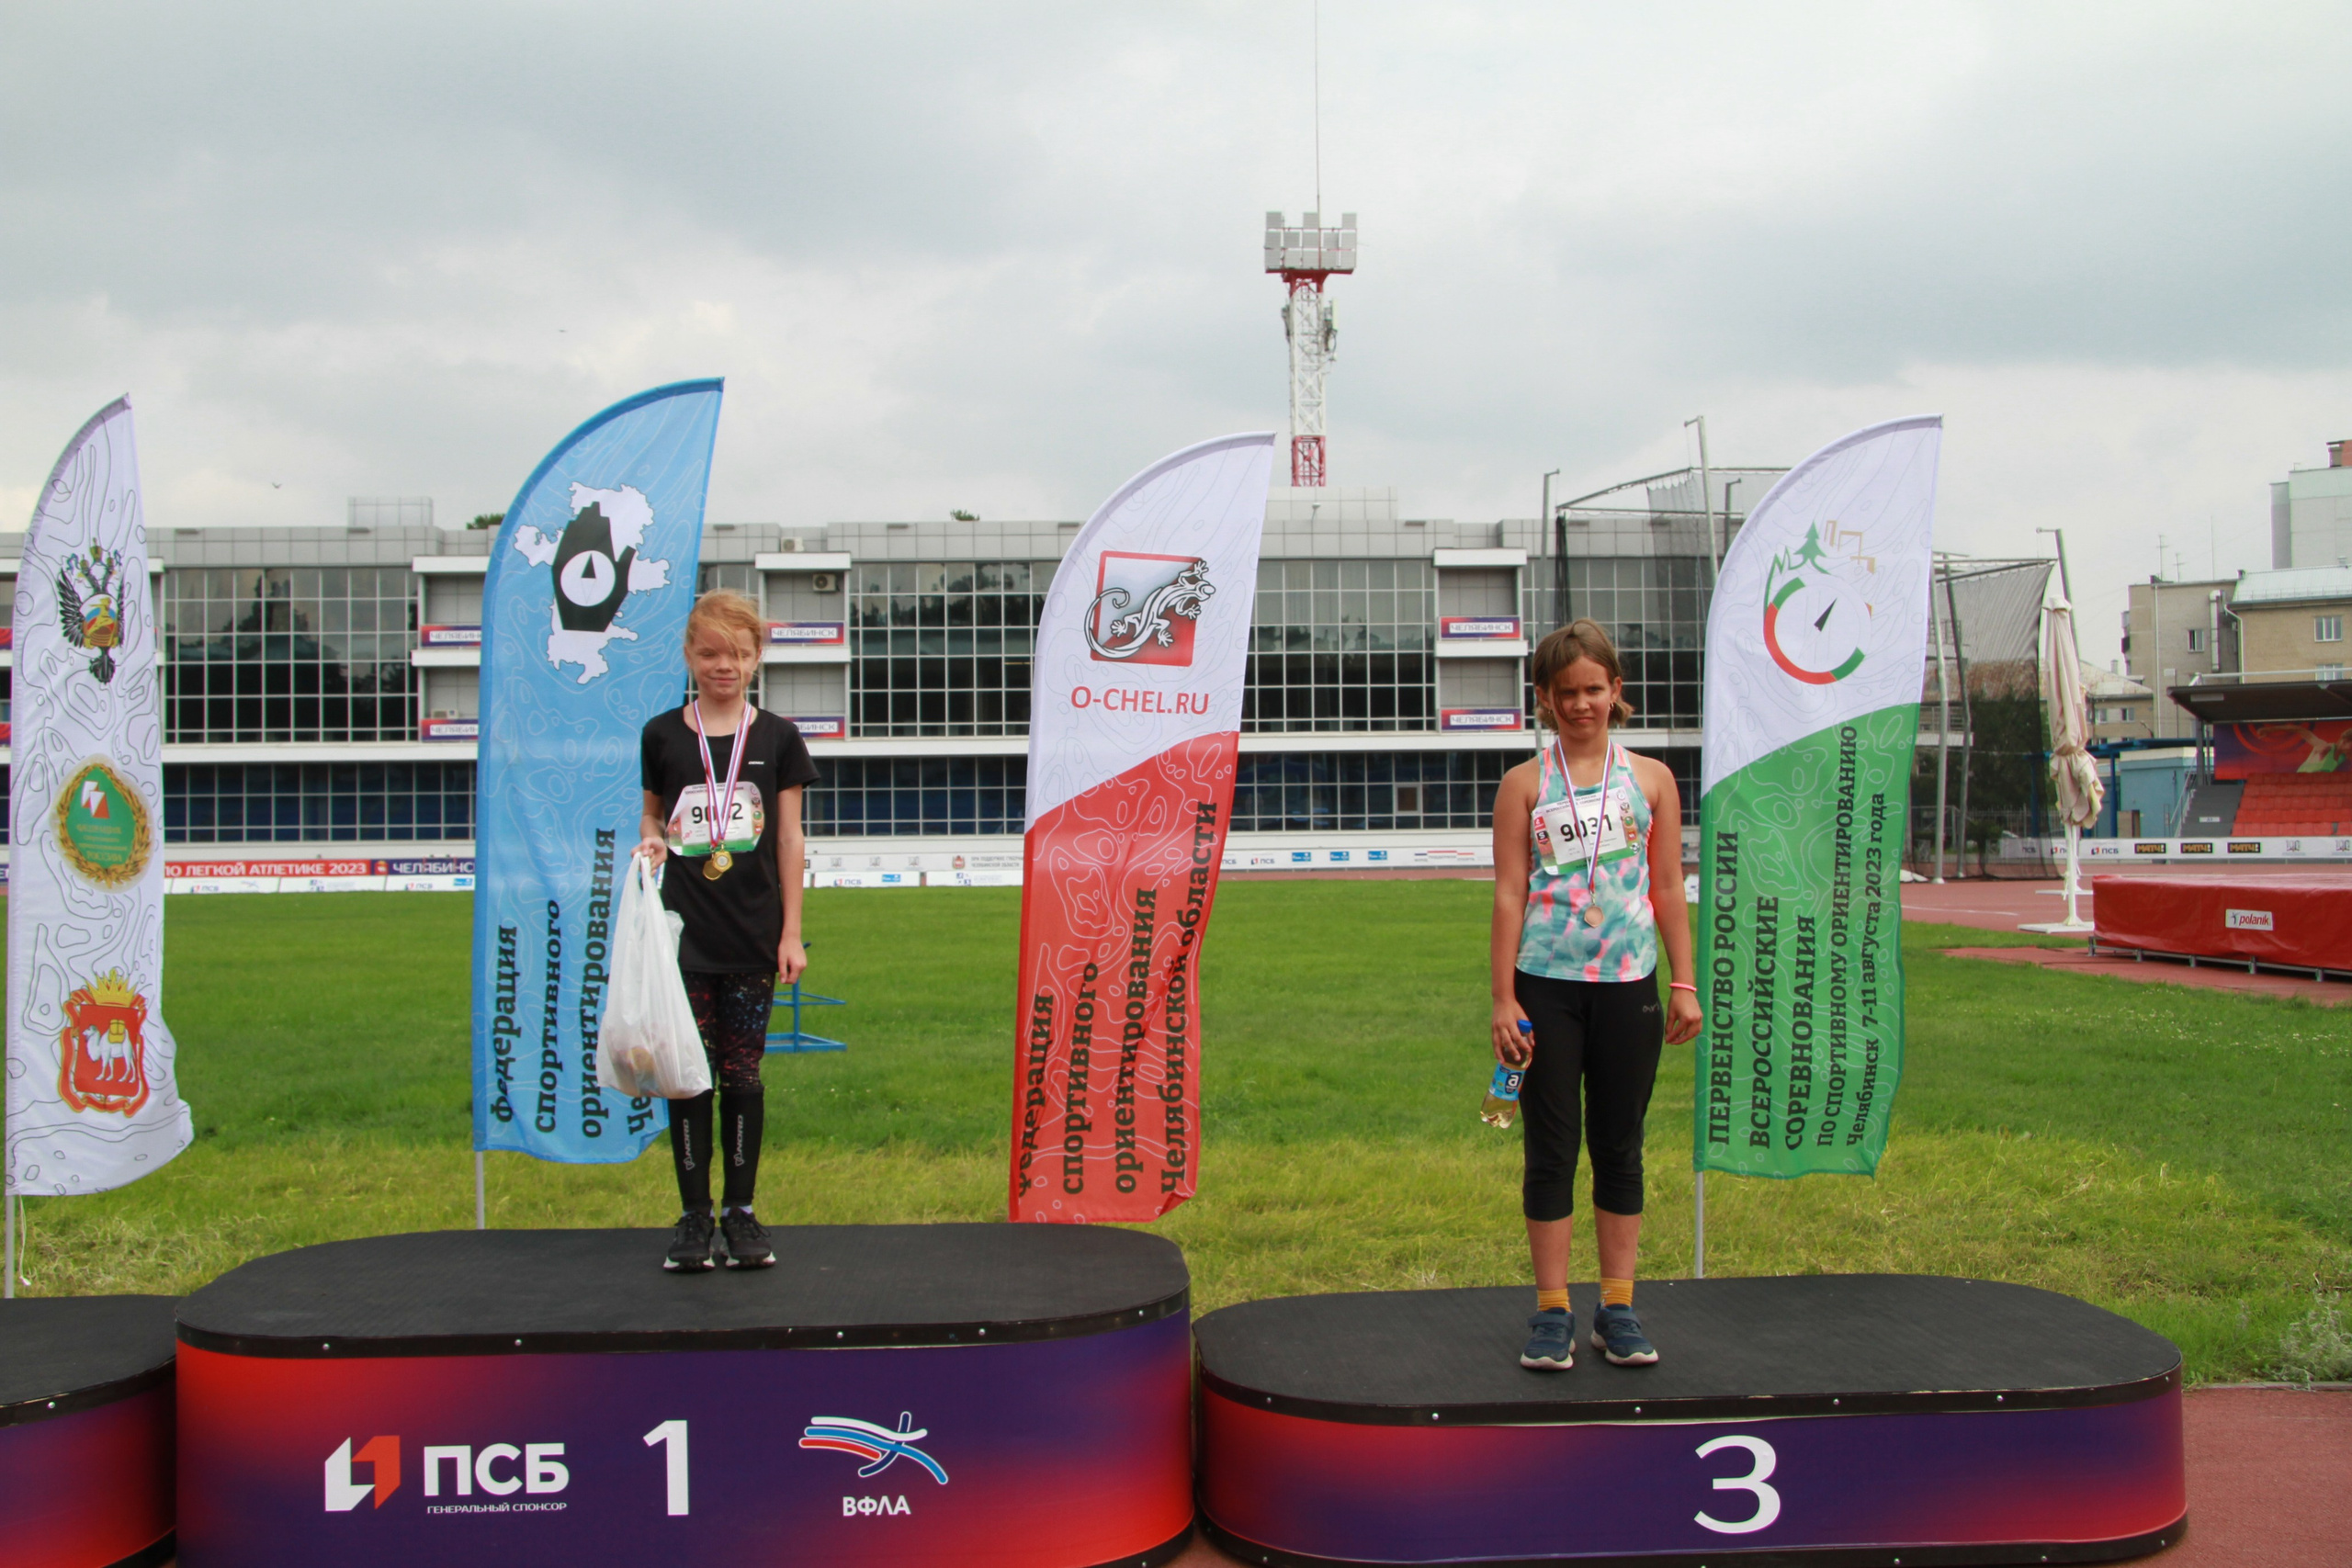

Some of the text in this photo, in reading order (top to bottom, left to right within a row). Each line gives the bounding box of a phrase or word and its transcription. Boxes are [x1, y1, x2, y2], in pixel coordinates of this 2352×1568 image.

[430, 631, 481, 639] ЧЕЛЯБИН
[773, 628, 835, 637] ЧЕЛЯБИНСК
[1451, 623, 1511, 631] ЧЕЛЯБИНСК
[430, 725, 478, 733] ЧЕЛЯБИН
[1070, 685, 1209, 715] O-CHEL.RU
[1451, 716, 1512, 724] ЧЕЛЯБИНСК
[691, 802, 744, 825] 902
[186, 862, 246, 876] ЛЕГКОЙ
[249, 863, 325, 875] АТЛЕТИКЕ
[328, 863, 367, 874] 2023
[392, 861, 475, 874] ЧЕЛЯБИНС
[579, 827, 616, 1138] ориентирования
[1816, 726, 1858, 1146] ПО СПОРТИВНОМУ ОРИЕНТИРОВАНИЮ
[1846, 792, 1886, 1146] Челябинск 7-11 августа 2023 года
[490, 924, 521, 1123] Федерация
[535, 899, 562, 1134] спортивного
[1157, 802, 1218, 1193] Челябинской области
[1709, 831, 1738, 1145] ПЕРВЕНСТВО РОССИИ
[1747, 896, 1779, 1150] ВСЕРОССИЙСКИЕ
[1785, 914, 1815, 1150] СОРЕВНОВАНИЯ
[1063, 962, 1098, 1193] спортивного
[1115, 887, 1157, 1193] ориентирования
[424, 1442, 570, 1496] ПСБ
[426, 1502, 567, 1514] ГЕНЕРАЛЬНЫЙ СПОНСОР
[642, 1419, 689, 1516] 1
[842, 1495, 911, 1517] ВФЛА
[1693, 1434, 1781, 1534] 3
